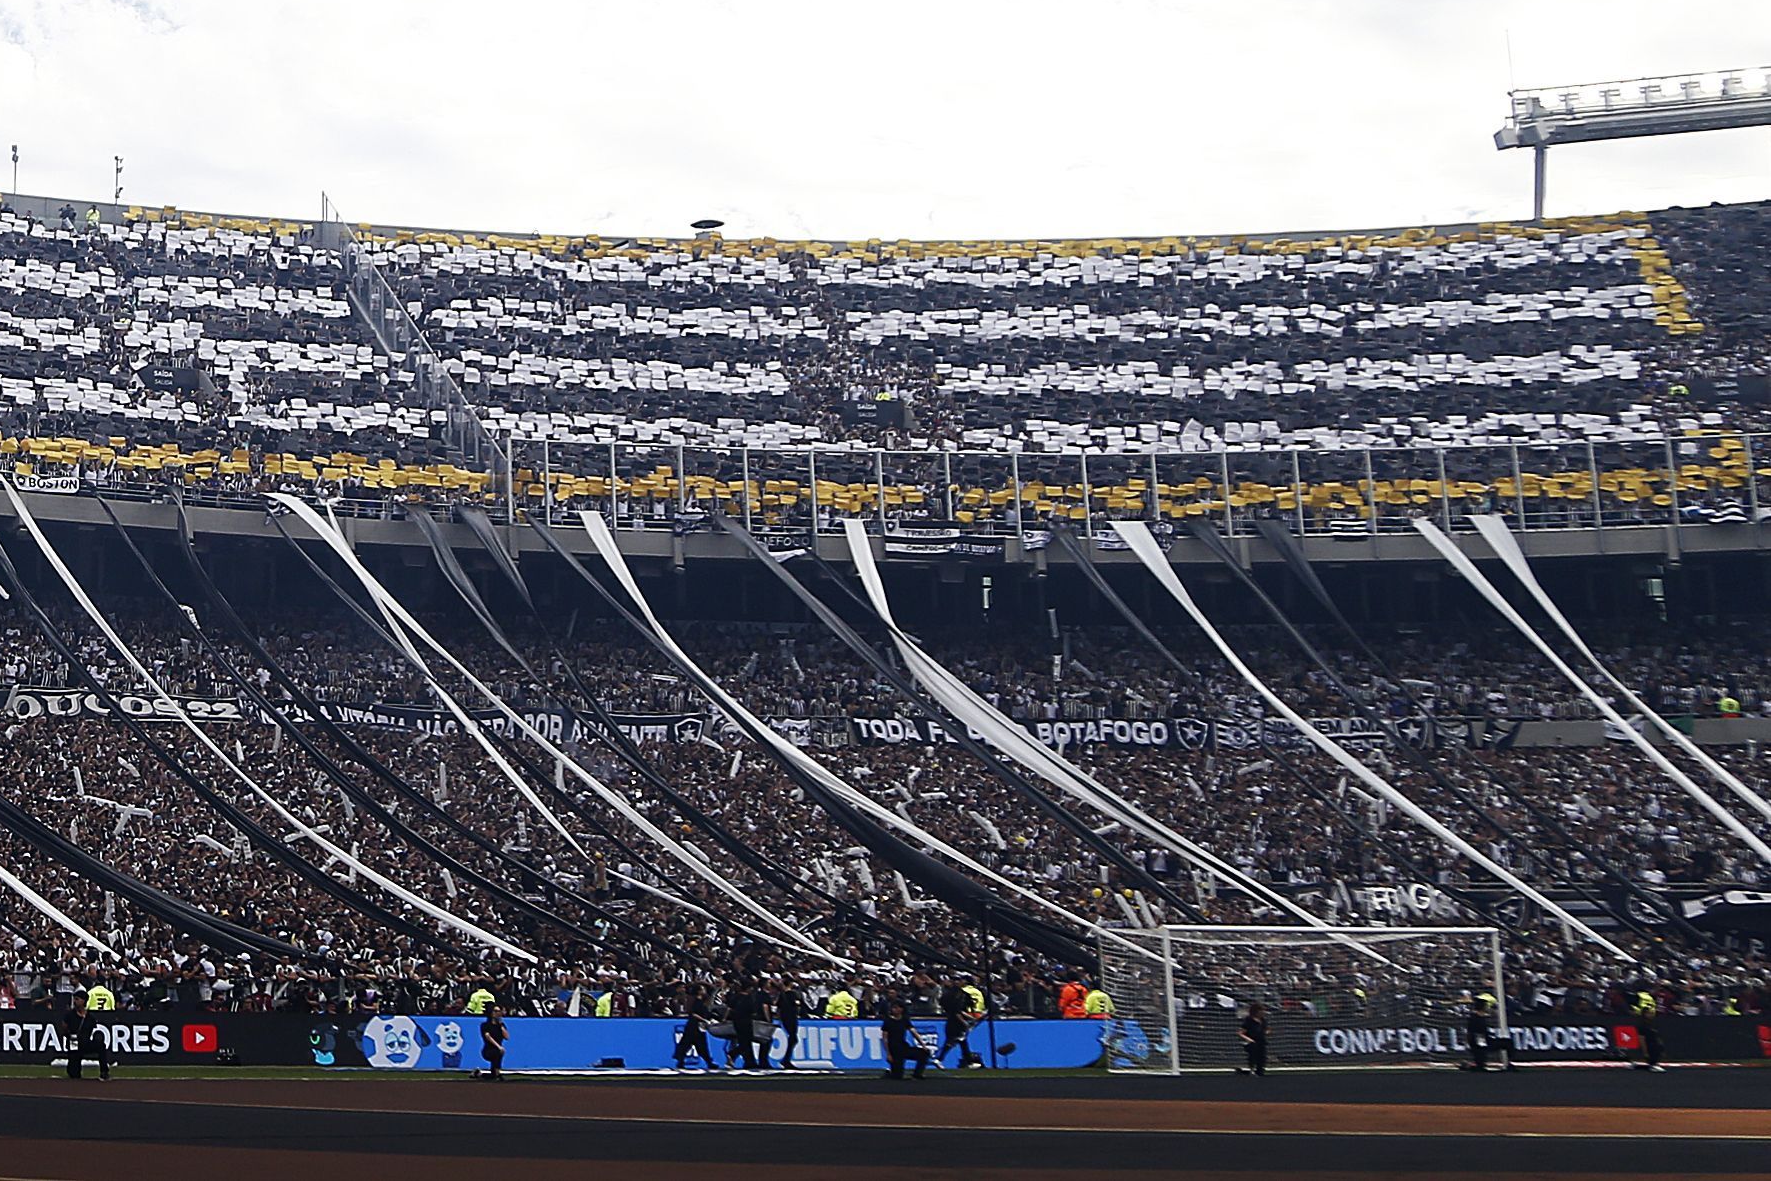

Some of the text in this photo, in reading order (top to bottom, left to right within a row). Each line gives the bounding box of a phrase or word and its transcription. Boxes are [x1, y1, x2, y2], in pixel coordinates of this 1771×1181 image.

[153, 370, 173, 378] SAÍDA
[29, 477, 78, 490] BOSTON
[185, 701, 241, 719] 22
[852, 717, 922, 743] TODA
[1035, 719, 1169, 746] BOTAFOGO
[752, 1025, 884, 1061] OTIFUT
[1450, 1026, 1610, 1052] LTADORES
